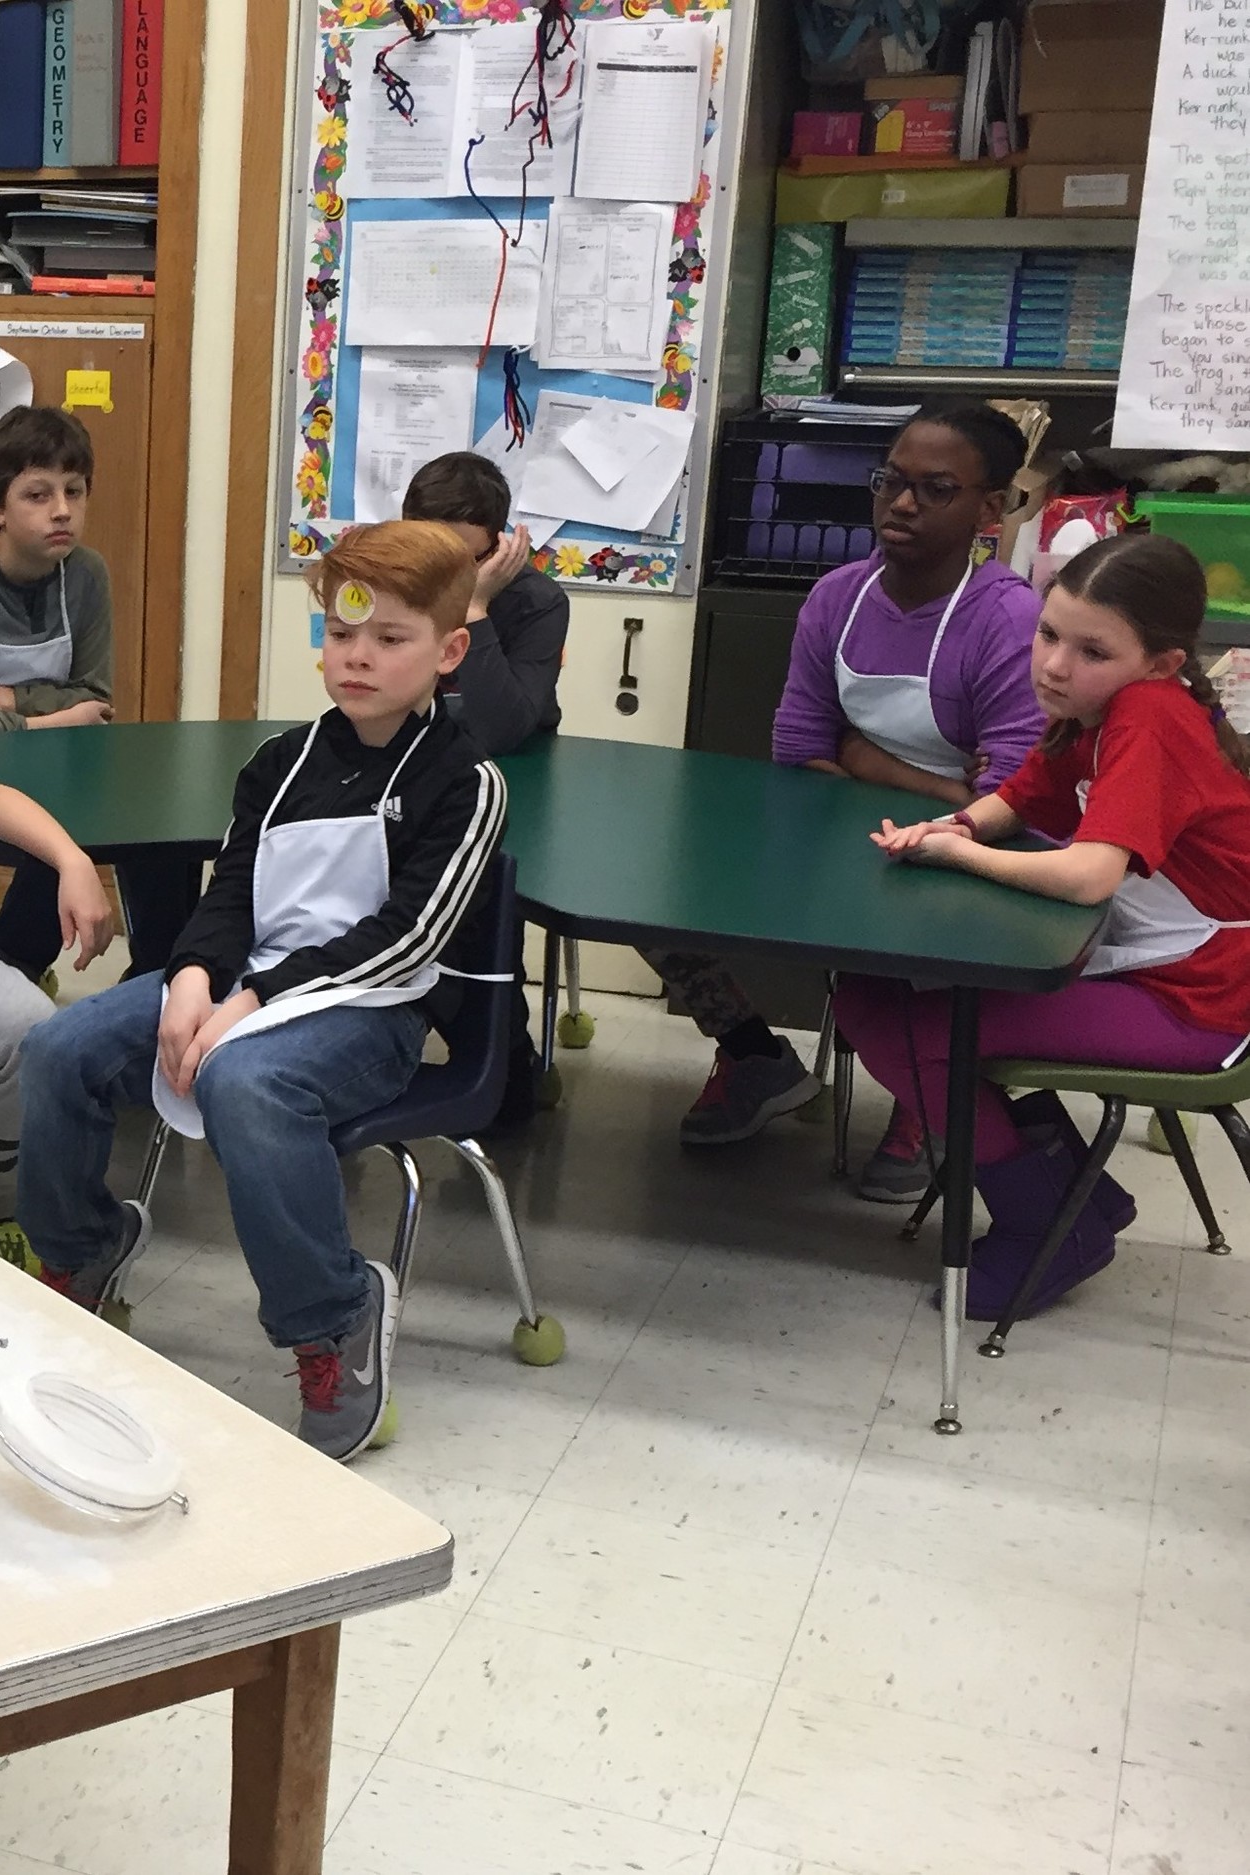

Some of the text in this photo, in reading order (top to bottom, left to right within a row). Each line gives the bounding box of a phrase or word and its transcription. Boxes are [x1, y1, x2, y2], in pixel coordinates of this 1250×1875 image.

[1219, 13, 1236, 28] he
[1217, 51, 1245, 62] was
[134, 0, 149, 143] LANGUAGE
[1183, 63, 1237, 79] A duck
[52, 8, 66, 153] GEOMETRY
[1210, 116, 1247, 136] they
[1170, 145, 1204, 165] The
[1205, 171, 1215, 181] a
[1168, 215, 1197, 231] The
[1199, 271, 1228, 281] was
[1157, 293, 1187, 313] The
[7, 323, 39, 336] September
[41, 325, 68, 335] October
[77, 325, 105, 335] November
[110, 325, 142, 337] December
[1194, 315, 1247, 332] whose
[1162, 328, 1207, 353] began
[1217, 334, 1234, 347] to
[1188, 352, 1212, 365] you
[1149, 361, 1184, 378] The
[69, 382, 108, 396] cheerful
[1185, 380, 1201, 395] all
[1181, 412, 1213, 434] they
[370, 803, 403, 822] adas
